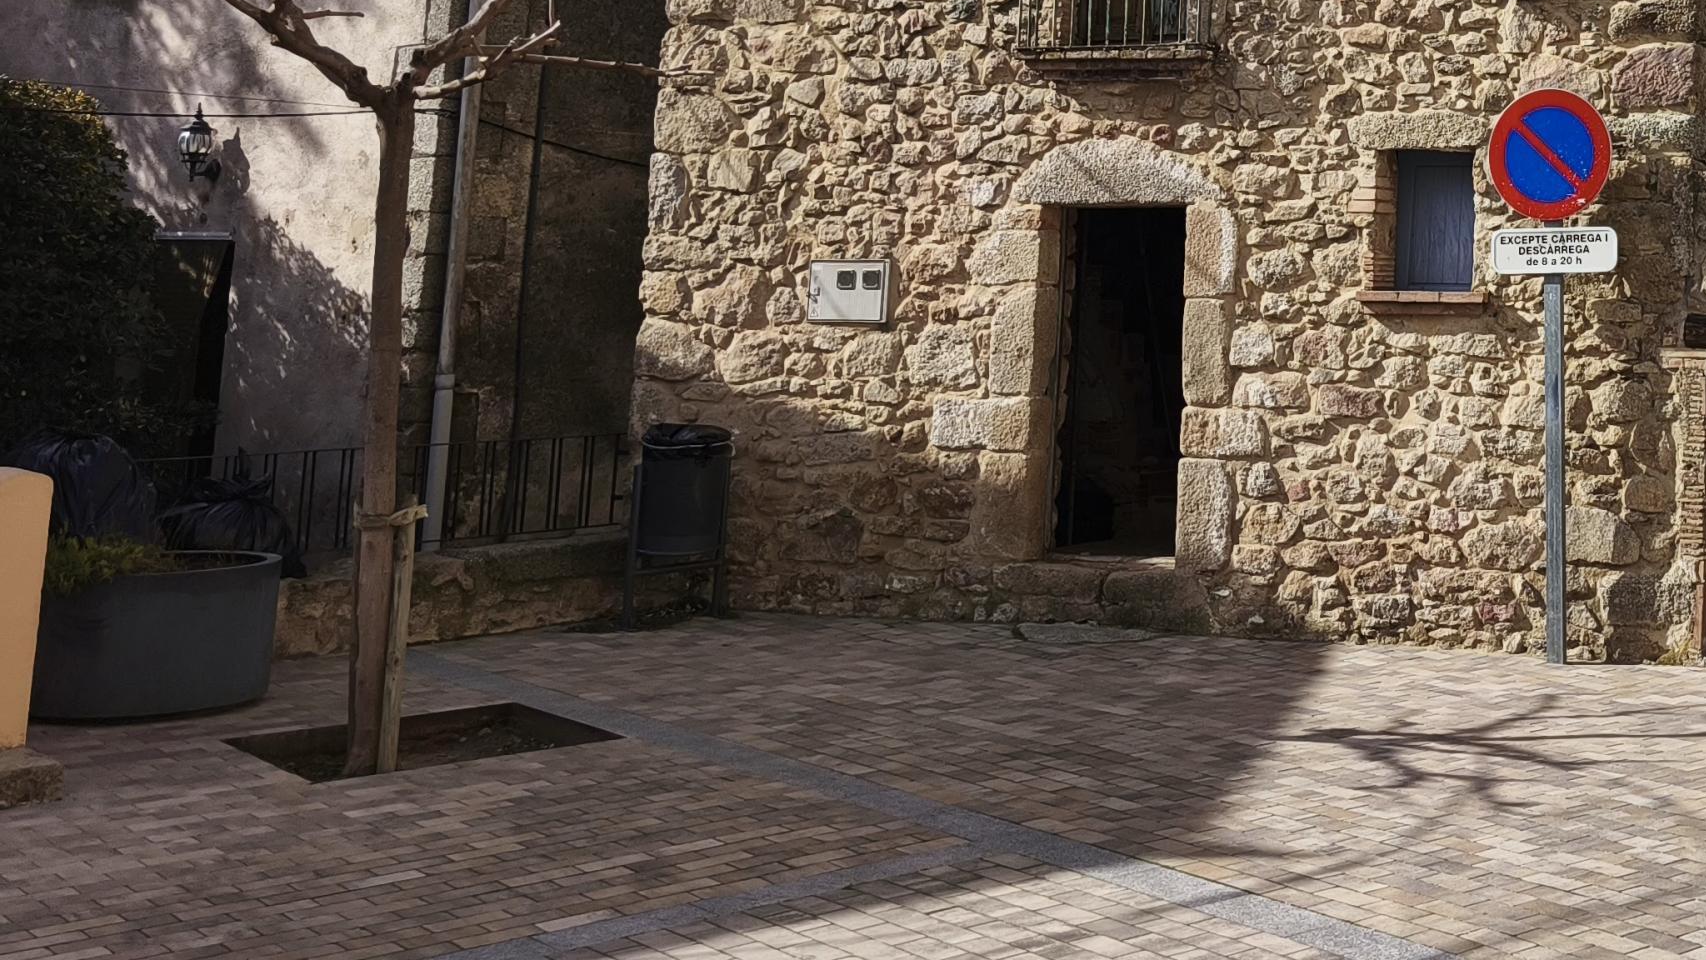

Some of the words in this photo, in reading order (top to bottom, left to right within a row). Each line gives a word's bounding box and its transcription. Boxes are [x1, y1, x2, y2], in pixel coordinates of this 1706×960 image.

[1500, 235, 1548, 245] EXCEPTE
[1605, 233, 1608, 242] I
[1526, 257, 1539, 266] de
[1541, 257, 1548, 265] 8
[1560, 256, 1573, 265] 20
[1576, 256, 1582, 264] h
